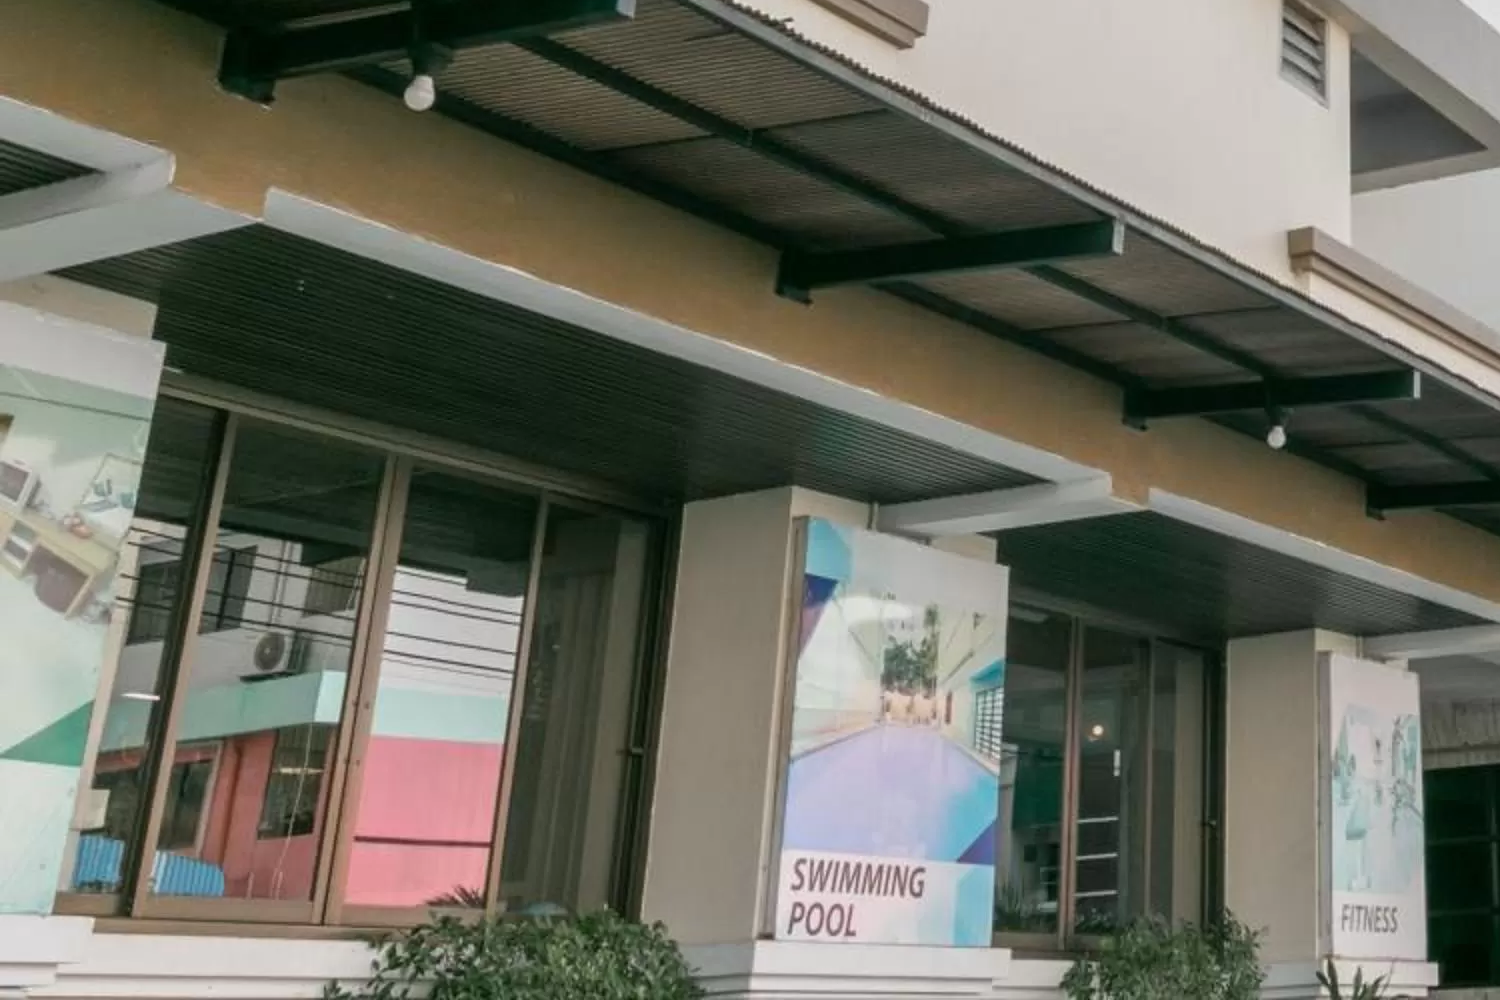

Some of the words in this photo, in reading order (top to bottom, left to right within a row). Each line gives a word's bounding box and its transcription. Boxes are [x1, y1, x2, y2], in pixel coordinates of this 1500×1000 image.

[790, 857, 927, 899] SWIMMING
[787, 901, 857, 937] POOL
[1341, 903, 1399, 933] FITNESS
